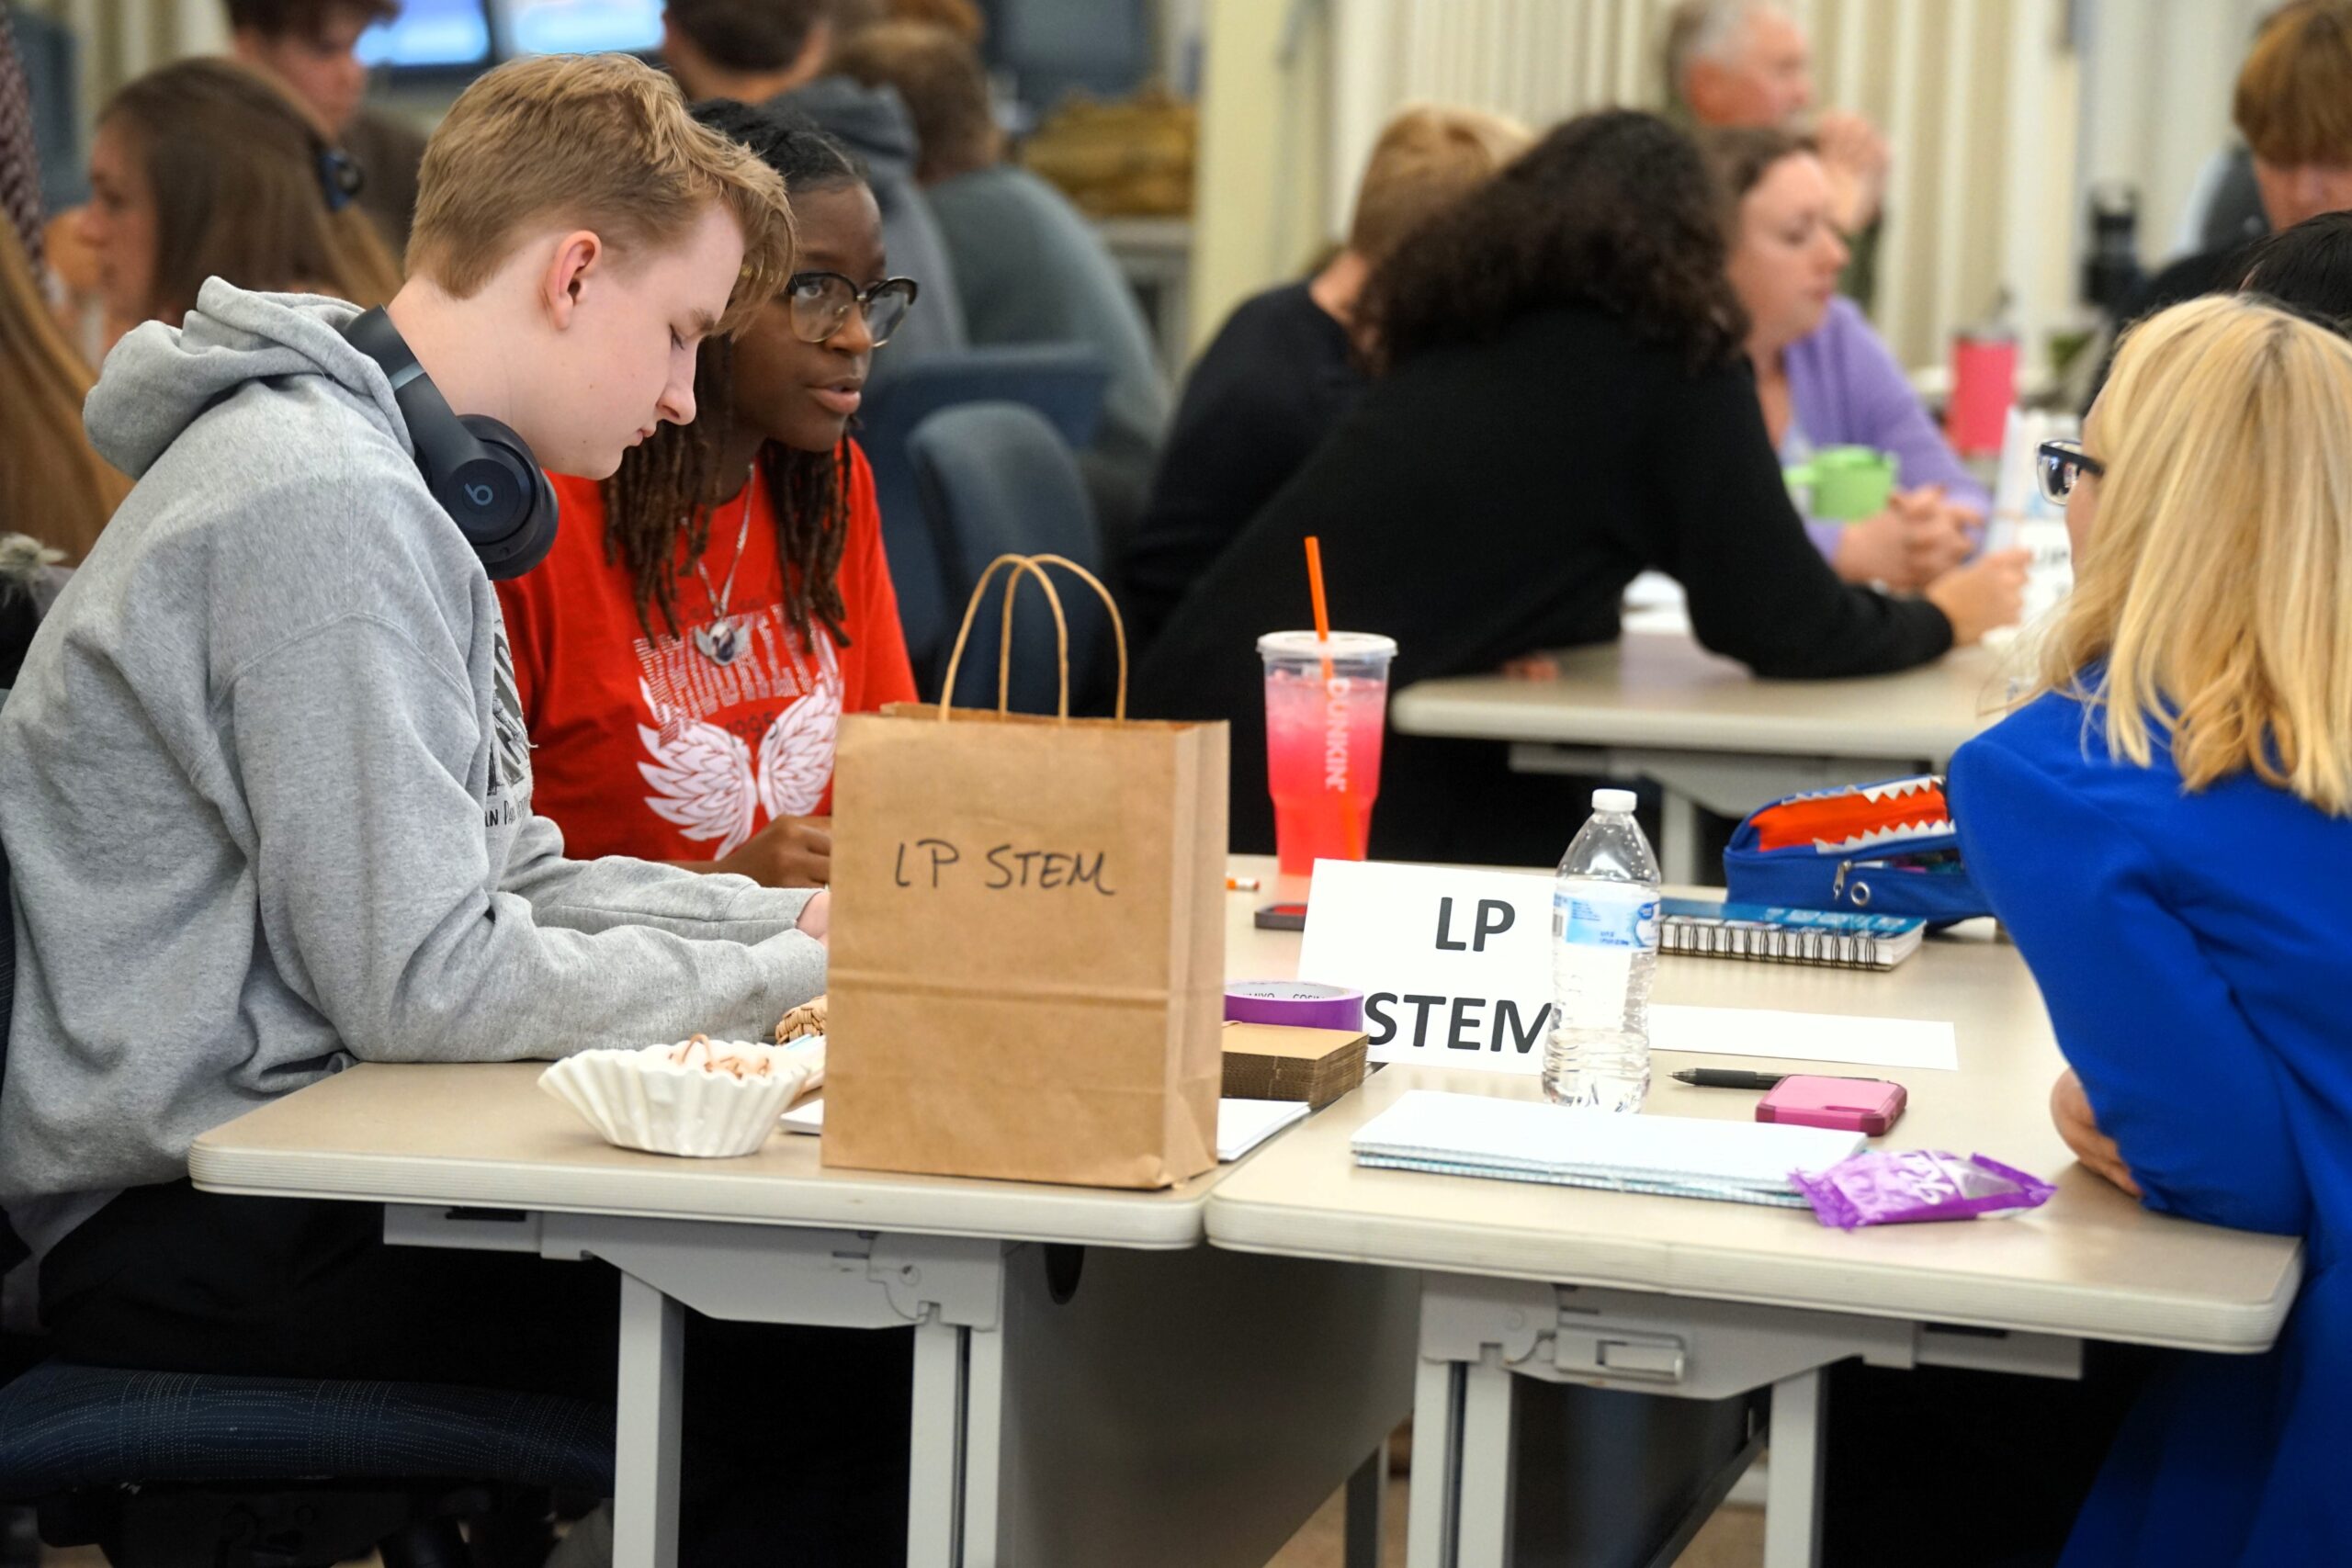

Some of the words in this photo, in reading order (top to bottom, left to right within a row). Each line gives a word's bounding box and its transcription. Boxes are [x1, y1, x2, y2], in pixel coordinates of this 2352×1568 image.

[895, 838, 960, 889] LP
[984, 843, 1116, 897] STEM
[1435, 897, 1516, 953] LP
[1364, 991, 1553, 1055] STEM
